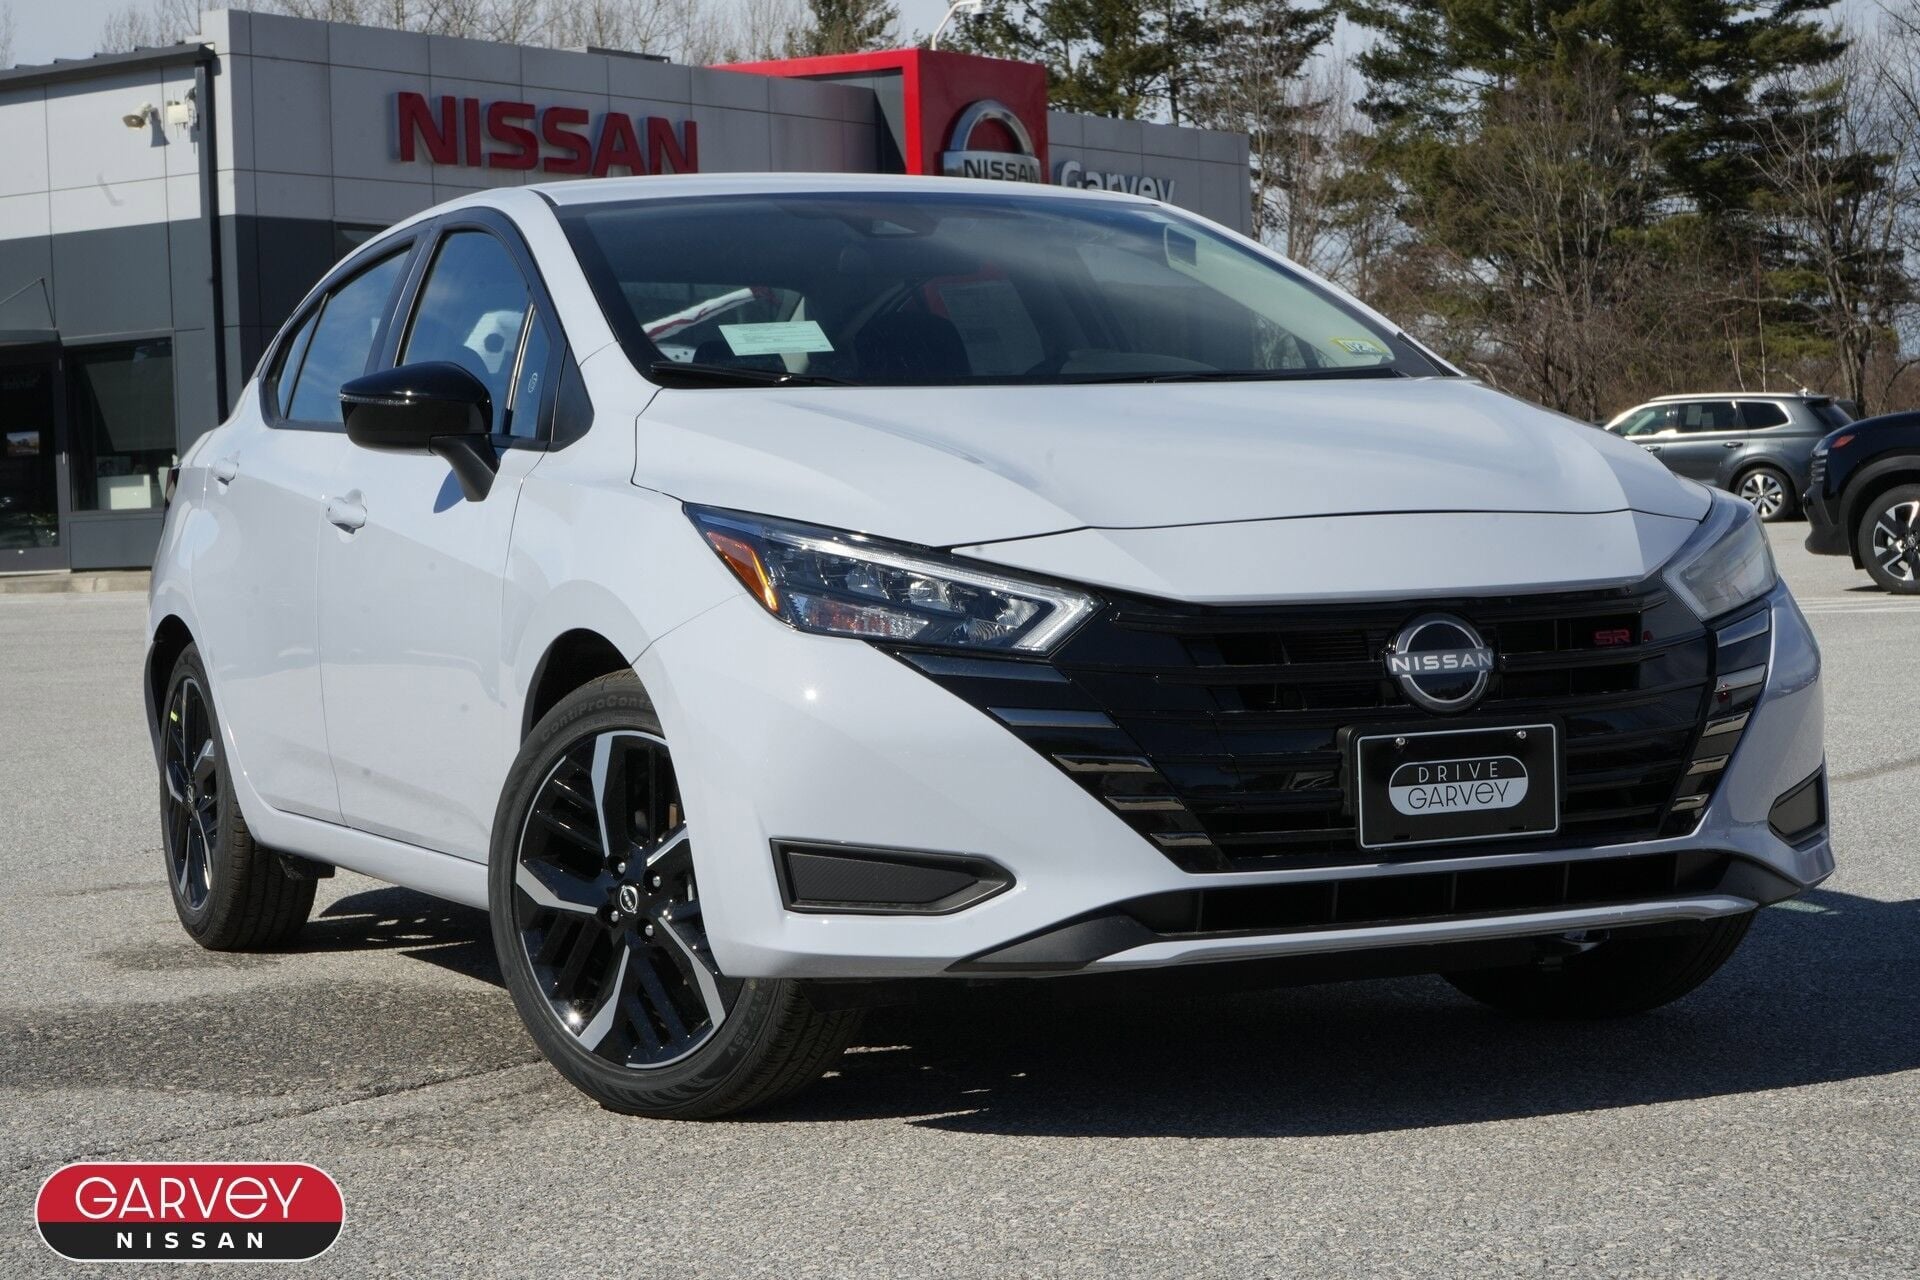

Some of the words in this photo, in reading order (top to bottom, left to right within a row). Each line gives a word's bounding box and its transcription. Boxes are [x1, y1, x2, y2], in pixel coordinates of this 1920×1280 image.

[397, 91, 698, 177] NISSAN
[964, 158, 1040, 184] NISSAN
[1058, 160, 1175, 202] Garvey
[1594, 628, 1631, 646] SR
[1391, 652, 1493, 672] NISSAN
[1418, 761, 1498, 783] DRIVE
